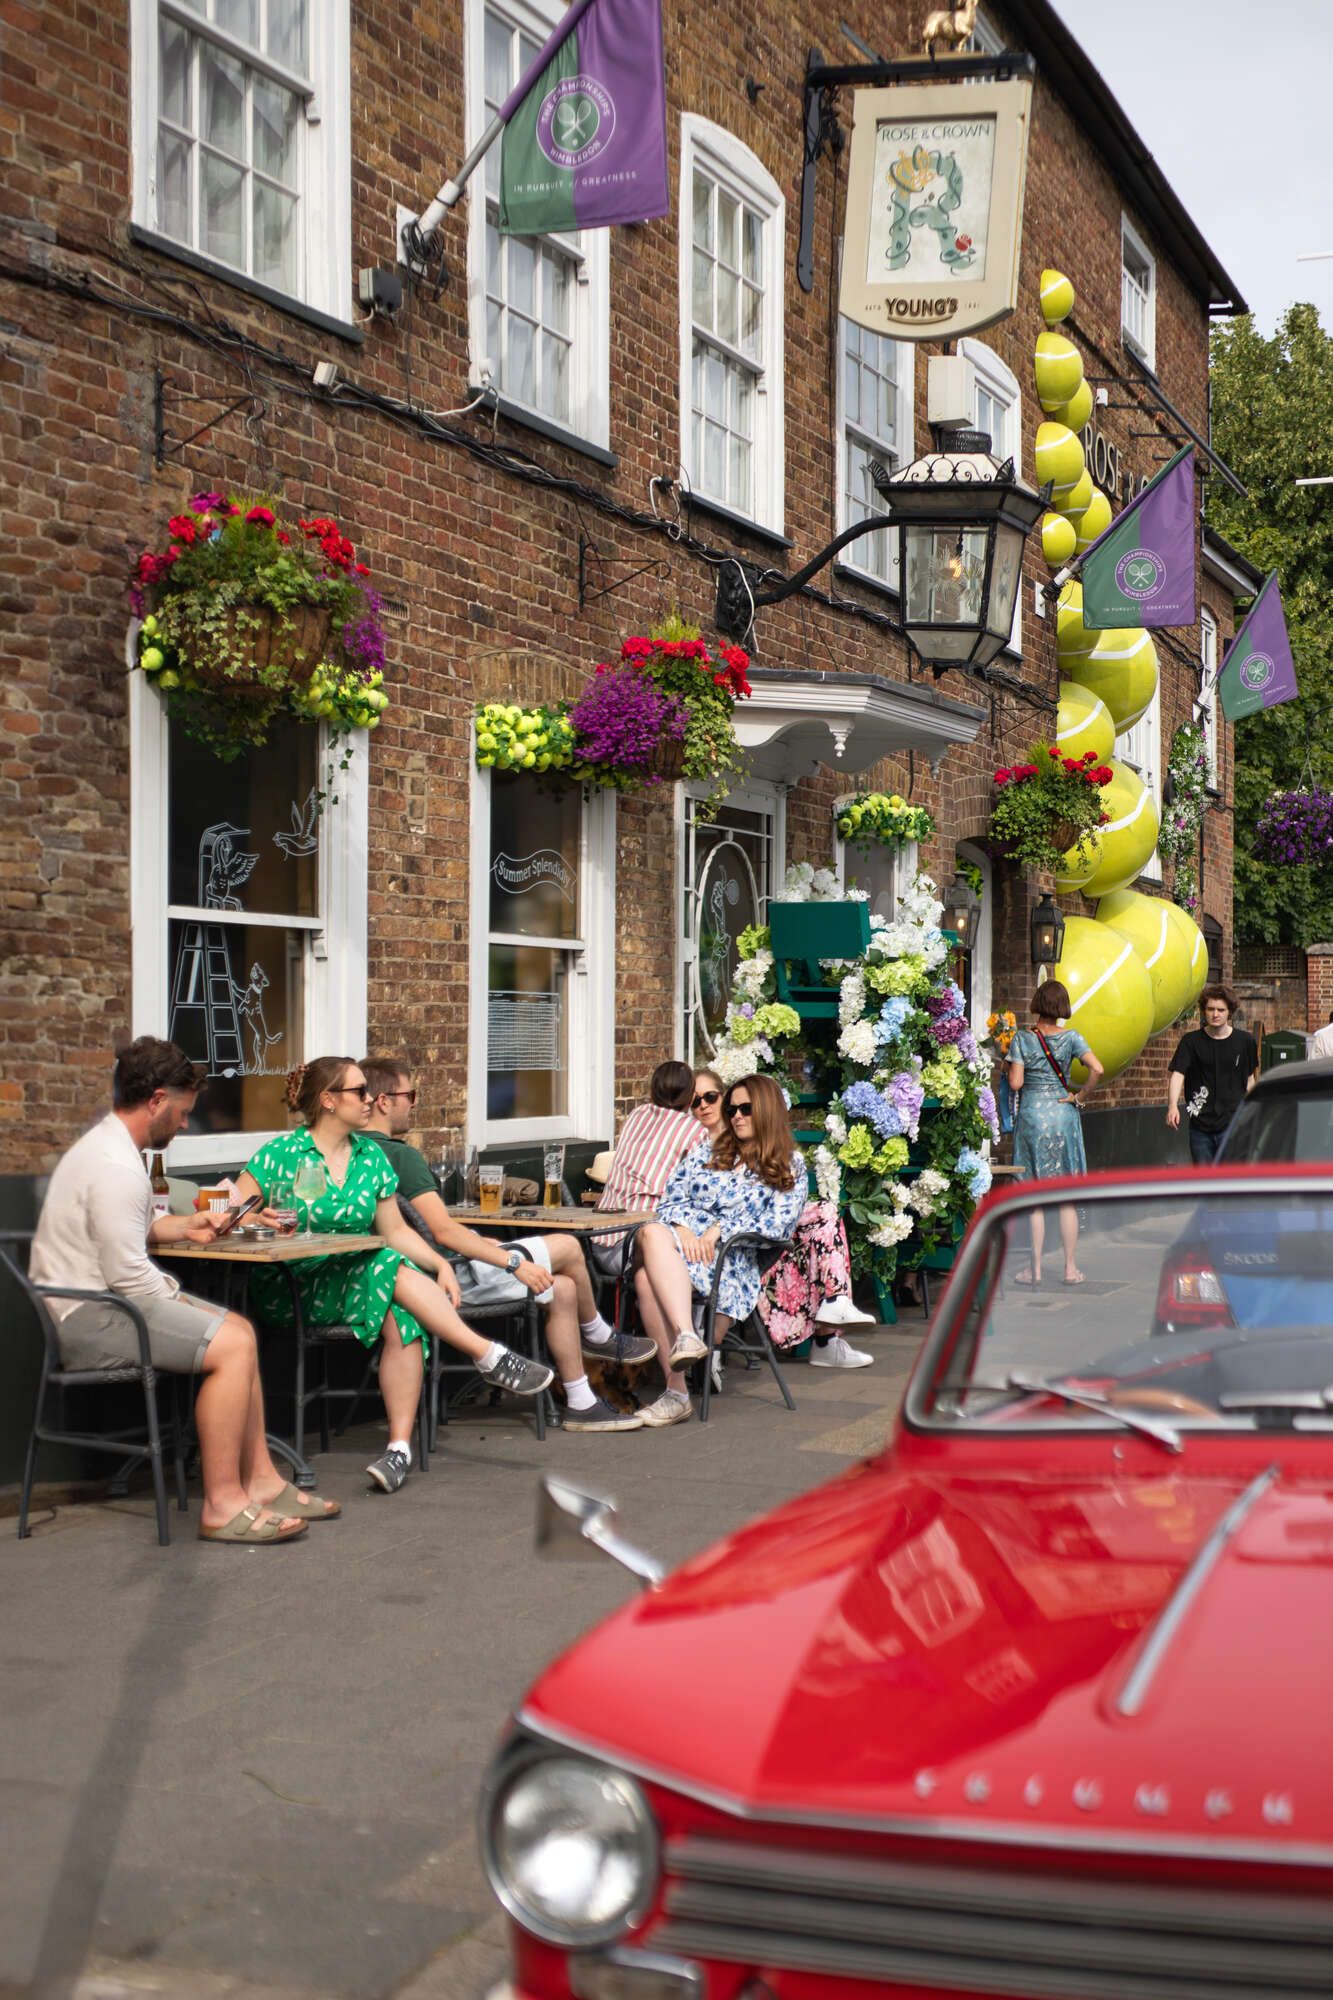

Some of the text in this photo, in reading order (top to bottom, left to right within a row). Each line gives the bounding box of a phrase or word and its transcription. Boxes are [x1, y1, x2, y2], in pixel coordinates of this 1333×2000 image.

[553, 80, 611, 117] CAMIONSHIPS
[882, 123, 990, 141] ROSE & CROWN
[550, 140, 601, 165] WIMBLEDON
[513, 184, 523, 193] IN
[527, 180, 563, 193] PURSUIT
[582, 171, 637, 187] GREATNESS
[885, 297, 959, 317] YOUNG'S
[1085, 422, 1123, 501] ROSE
[498, 860, 531, 883] Summer
